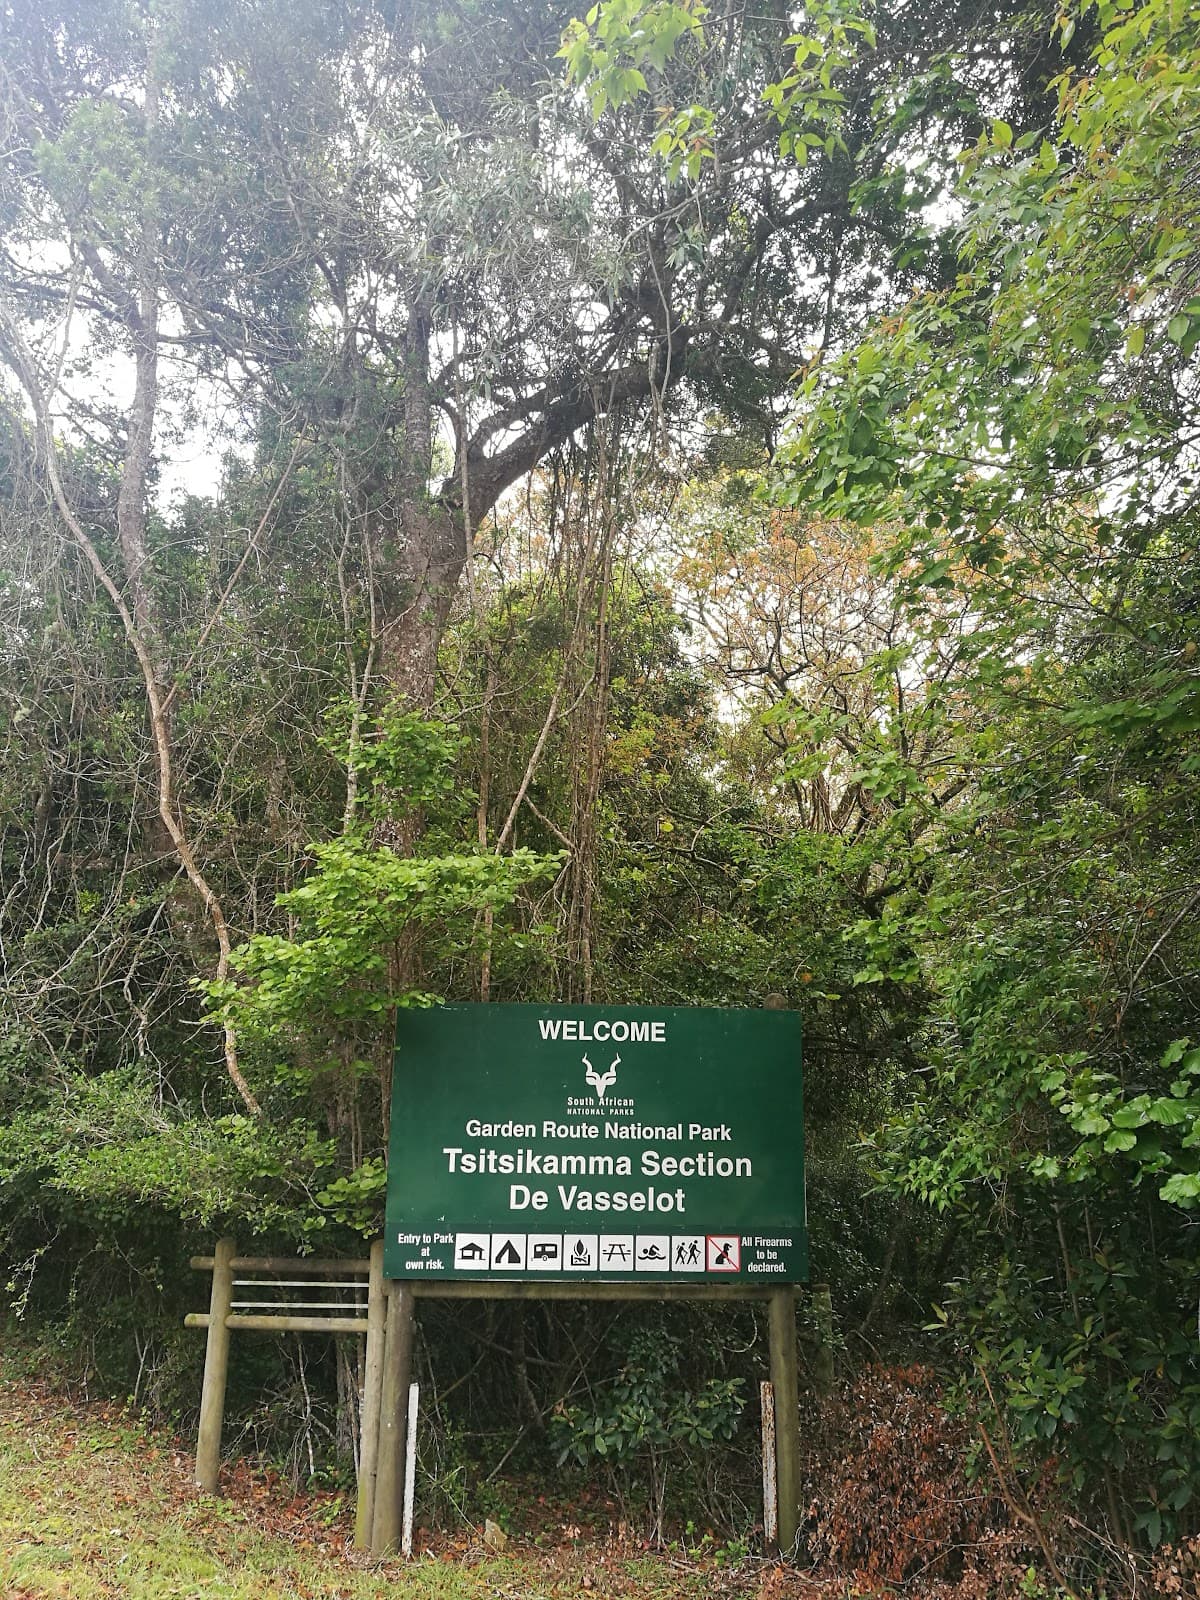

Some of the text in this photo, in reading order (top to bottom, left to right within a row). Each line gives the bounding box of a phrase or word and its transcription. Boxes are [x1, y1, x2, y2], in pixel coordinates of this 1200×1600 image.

[538, 1019, 667, 1042] WELCOME
[567, 1096, 634, 1106] South African
[567, 1108, 635, 1116] NATIONAL PARKS
[465, 1119, 732, 1141] Garden Route National Park
[443, 1147, 752, 1177] Tsitsikamma Section
[509, 1184, 686, 1213] De Vasselot
[398, 1233, 454, 1246] Entry to Park
[741, 1236, 793, 1247] All Firearms
[421, 1247, 431, 1257] at
[756, 1249, 778, 1260] to be
[405, 1259, 445, 1271] own risk.
[747, 1262, 787, 1273] declared.
